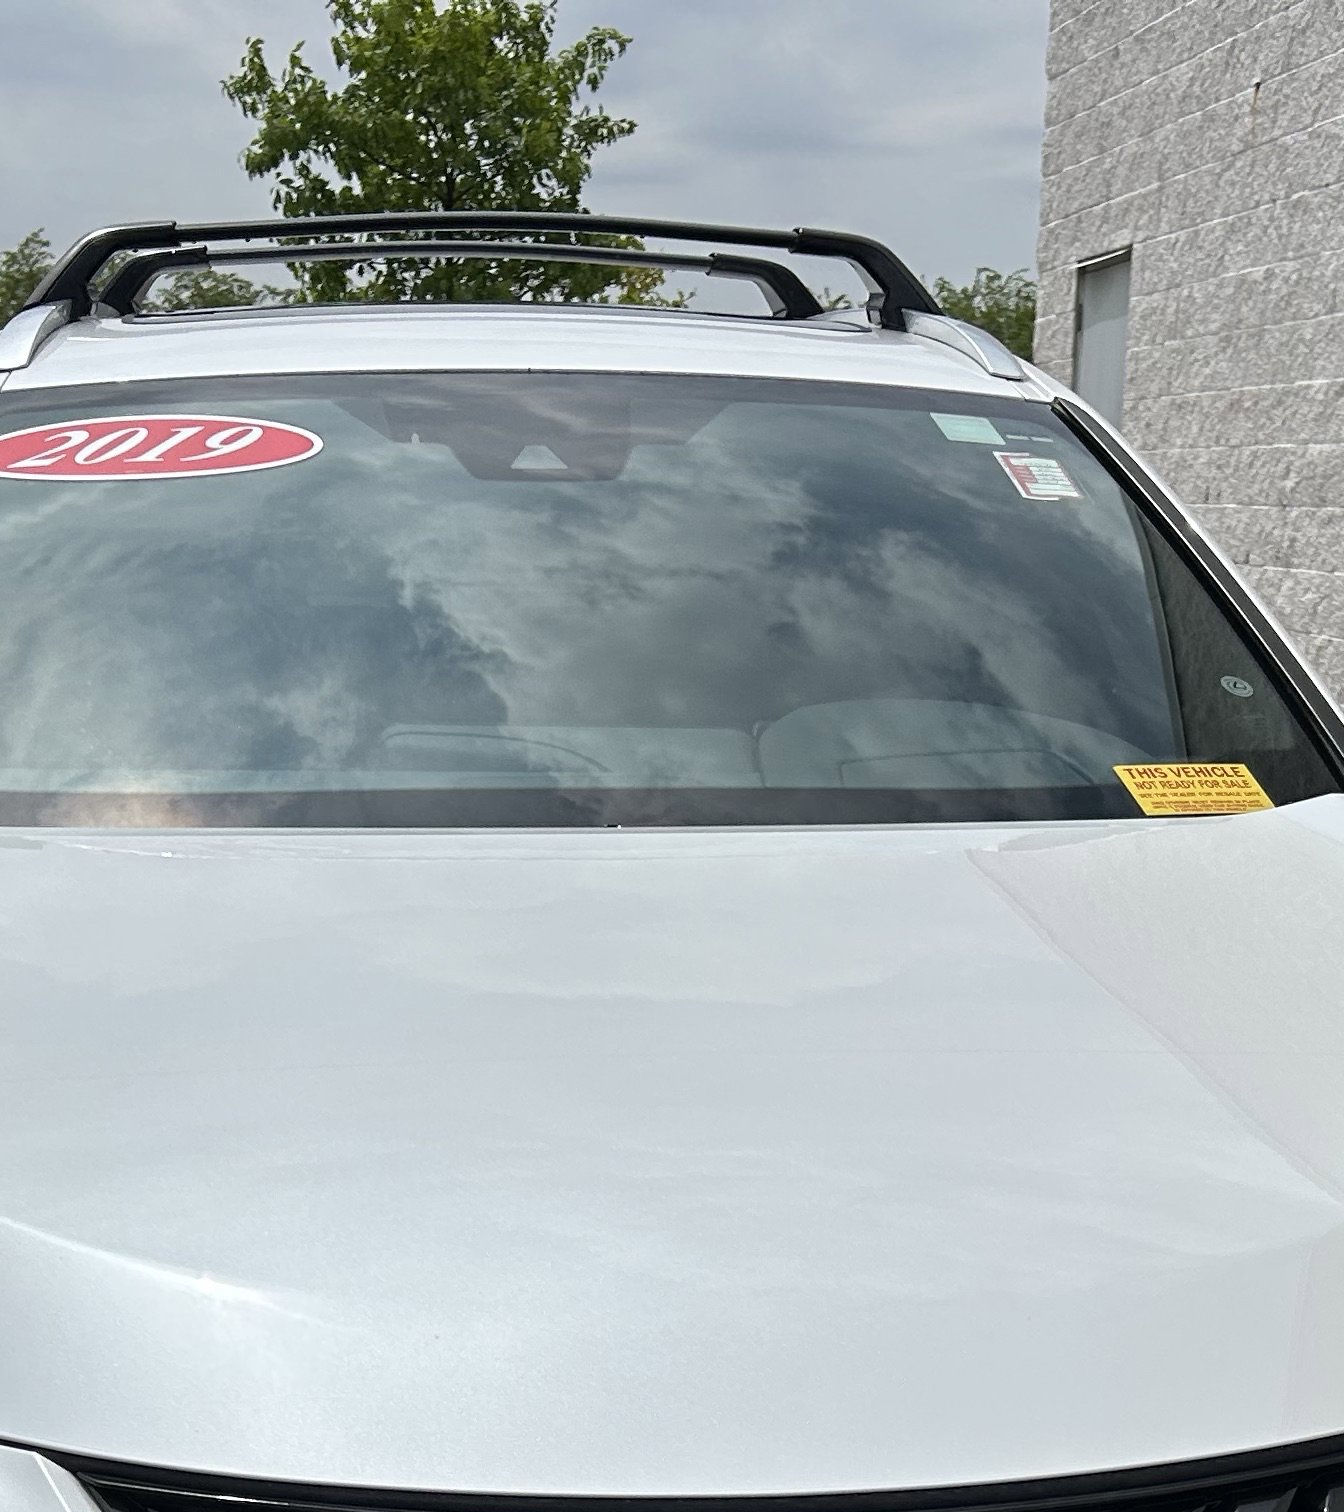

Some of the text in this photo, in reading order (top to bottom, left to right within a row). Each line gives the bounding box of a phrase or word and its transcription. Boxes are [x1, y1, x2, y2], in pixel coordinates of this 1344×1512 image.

[7, 426, 263, 468] 2019
[1123, 766, 1246, 780] THIS VEHICLE
[1133, 779, 1253, 791] NOT READY FOR SALE
